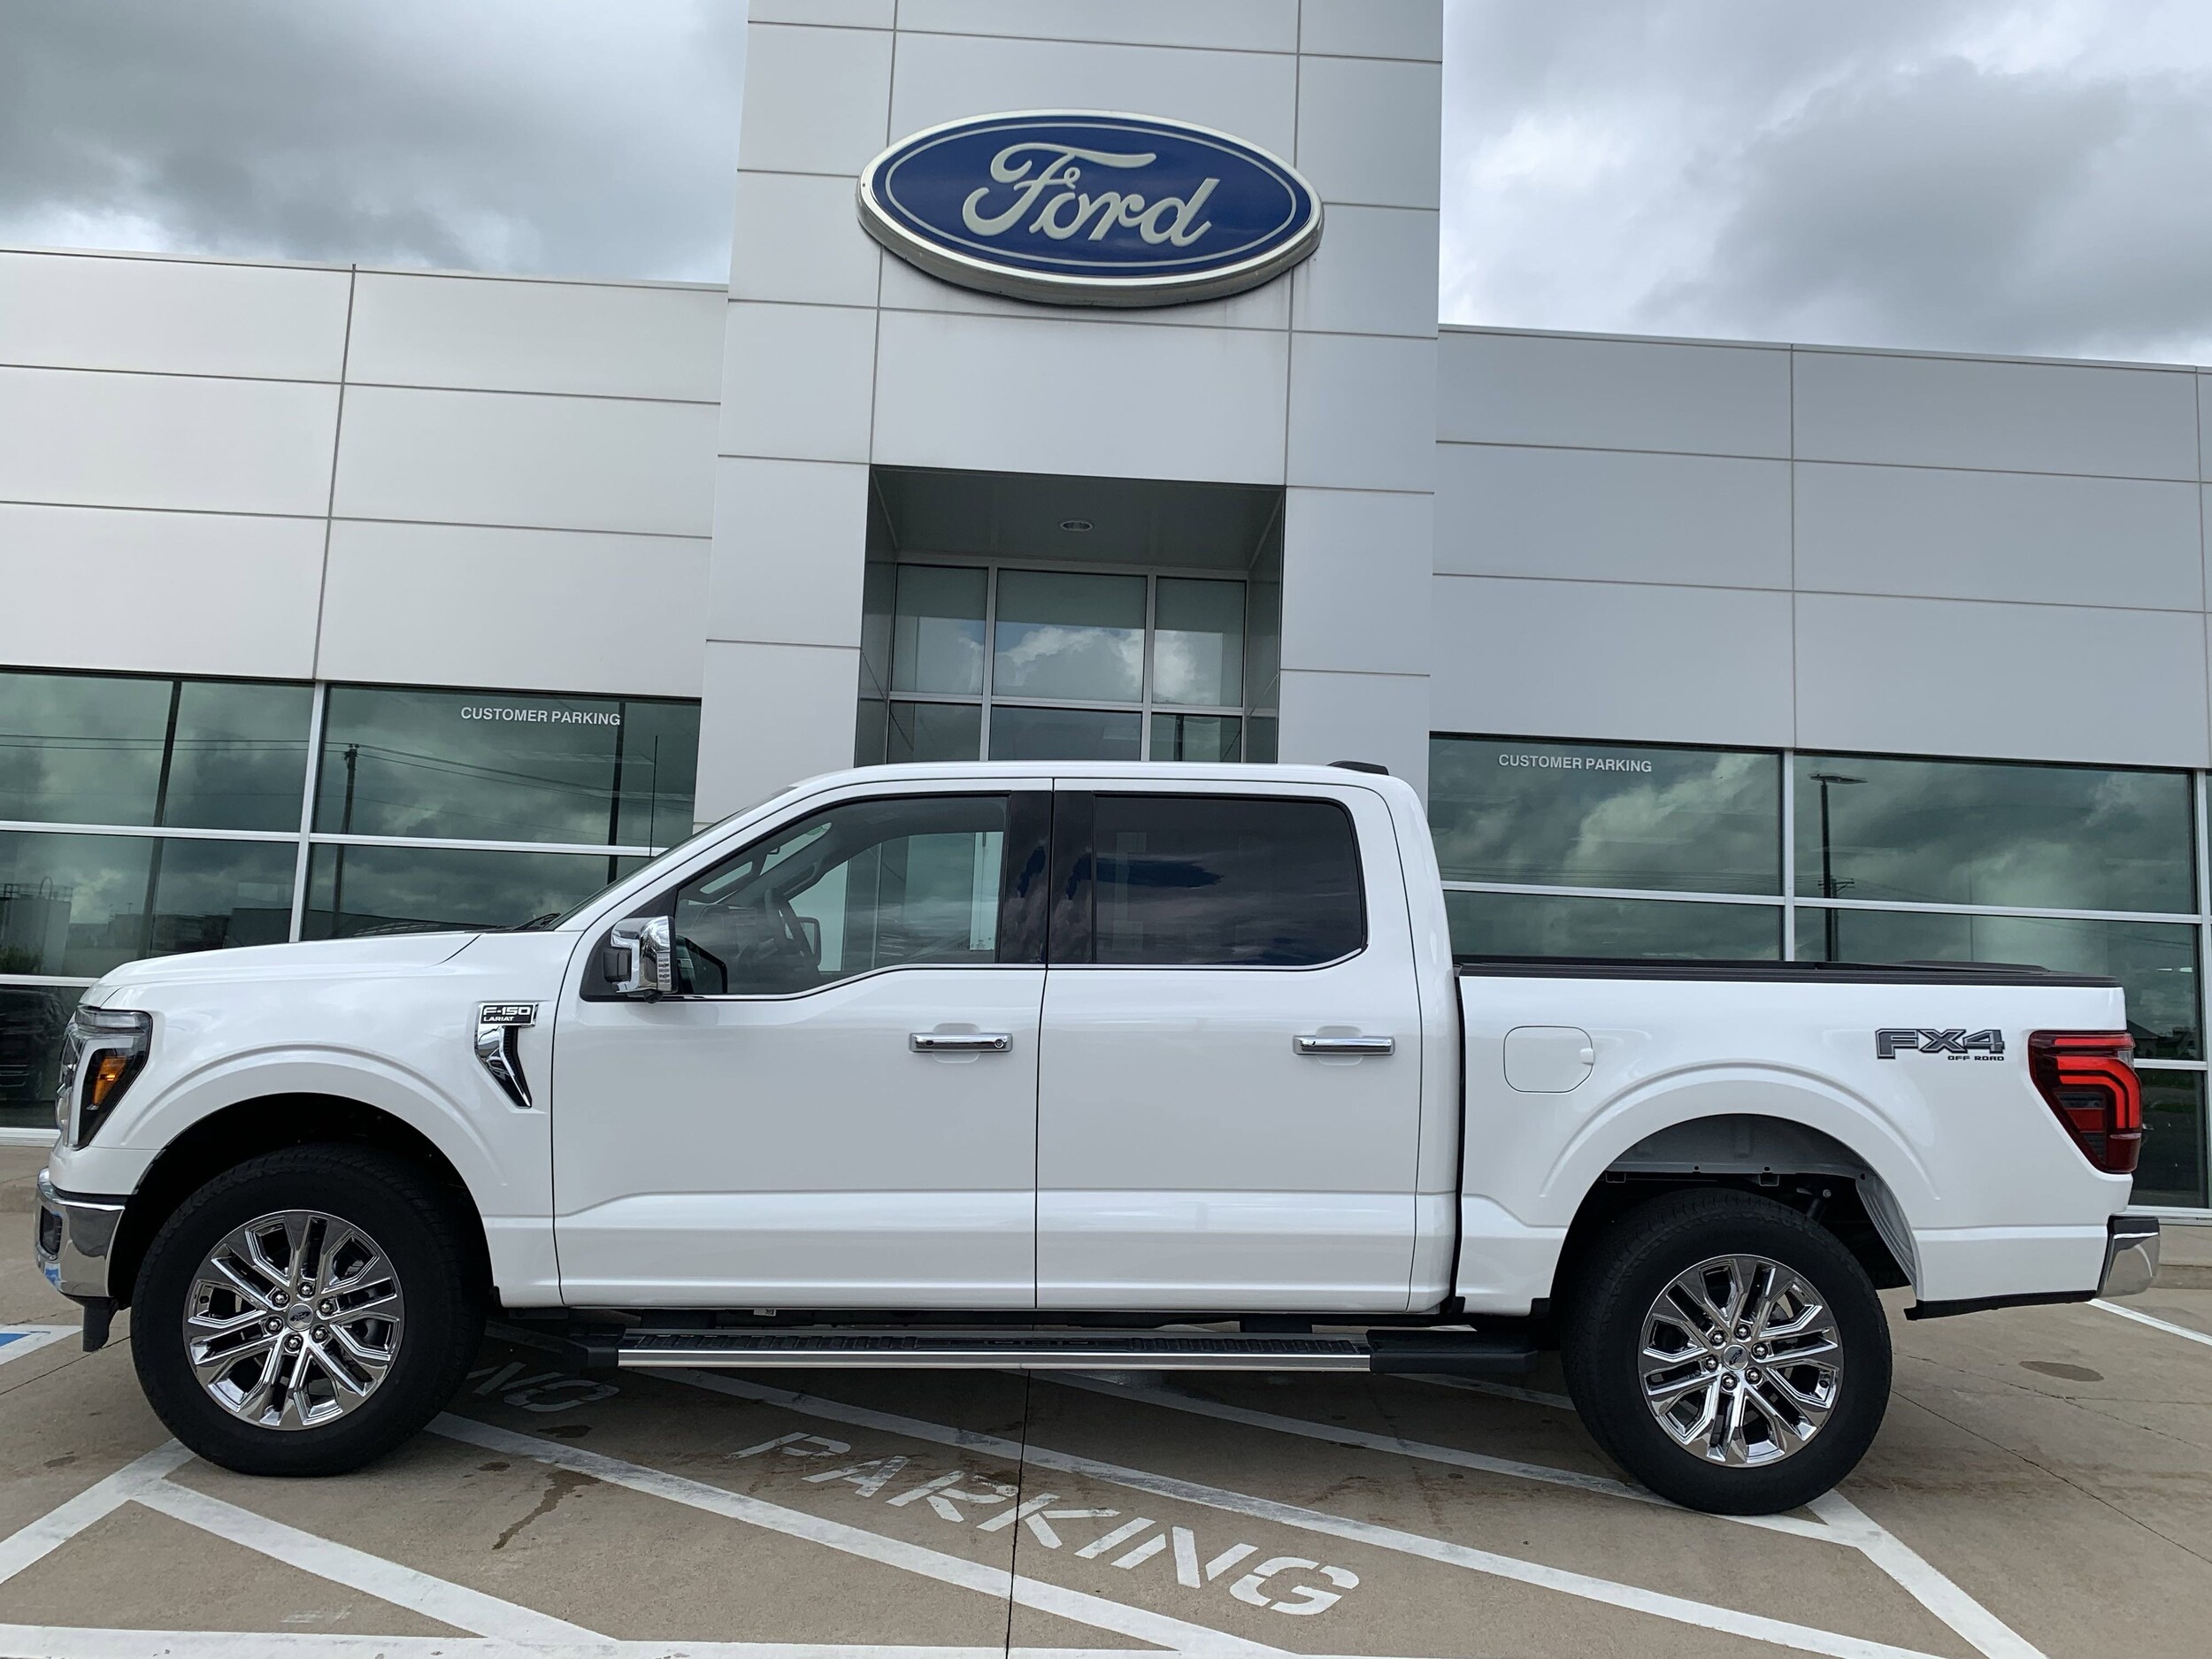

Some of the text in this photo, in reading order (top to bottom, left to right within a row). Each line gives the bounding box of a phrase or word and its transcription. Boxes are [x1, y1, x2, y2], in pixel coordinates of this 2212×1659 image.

[962, 142, 1221, 248] Ford
[460, 707, 621, 726] CUSTOMER PARKING
[1498, 754, 1652, 772] CUSTOMER PARKING
[483, 1006, 532, 1016] F-150
[1875, 1028, 2005, 1060] FX4
[724, 1432, 1360, 1616] PARKING
